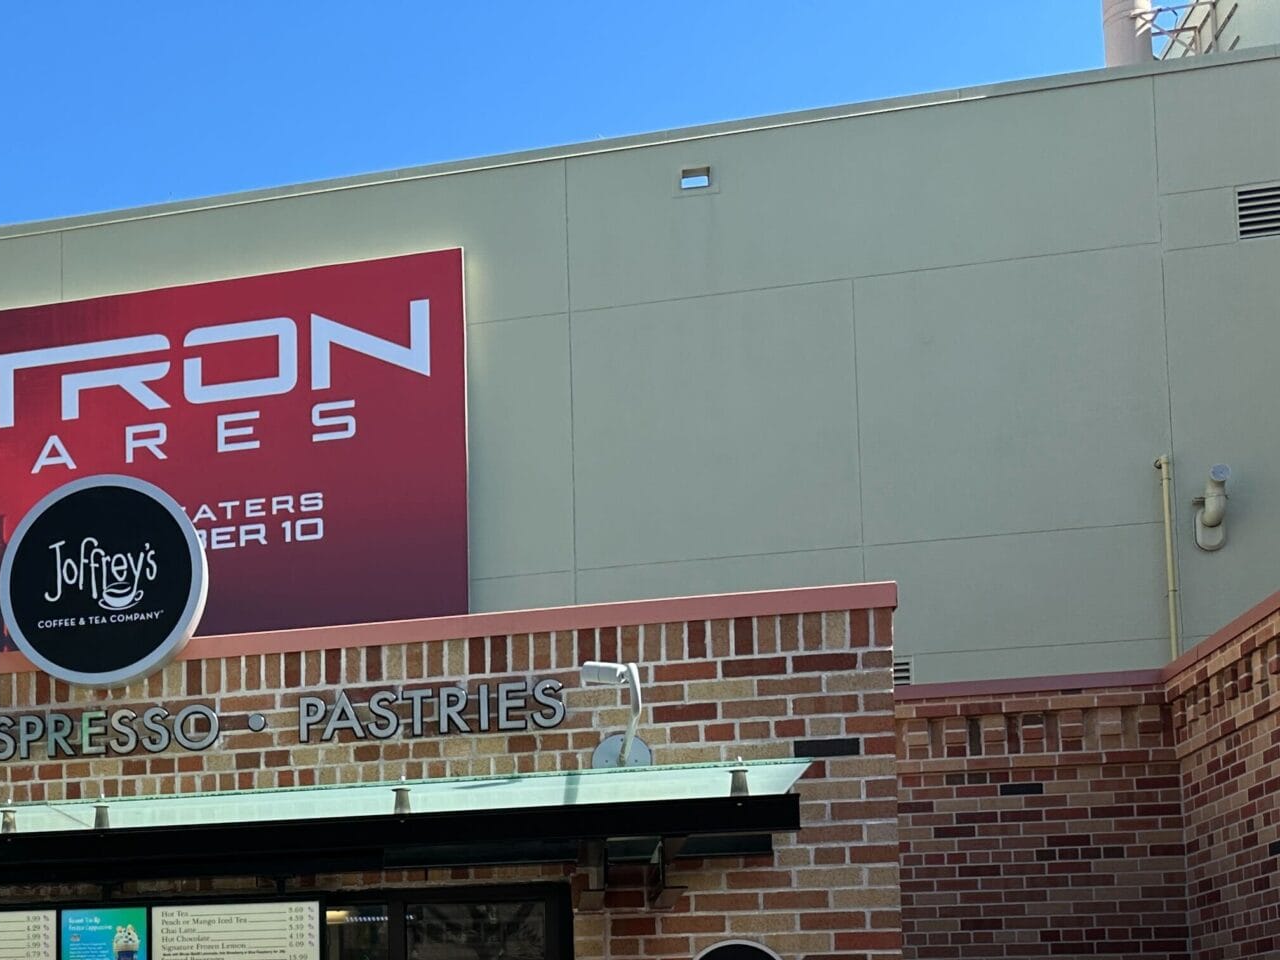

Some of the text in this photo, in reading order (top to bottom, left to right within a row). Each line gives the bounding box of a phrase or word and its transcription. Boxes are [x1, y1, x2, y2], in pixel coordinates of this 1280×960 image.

[31, 399, 356, 474] ARES
[181, 492, 323, 523] ATERS
[281, 517, 323, 542] 10
[44, 537, 157, 602] Joffrey's
[38, 617, 76, 629] COFFEE
[78, 617, 86, 626] &
[88, 616, 107, 625] TEA
[298, 678, 567, 744] PASTRIES
[160, 927, 177, 935] Chai
[192, 918, 216, 927] Mango
[218, 917, 233, 925] Iced
[161, 944, 194, 952] Signature
[176, 935, 210, 943] Chocolate
